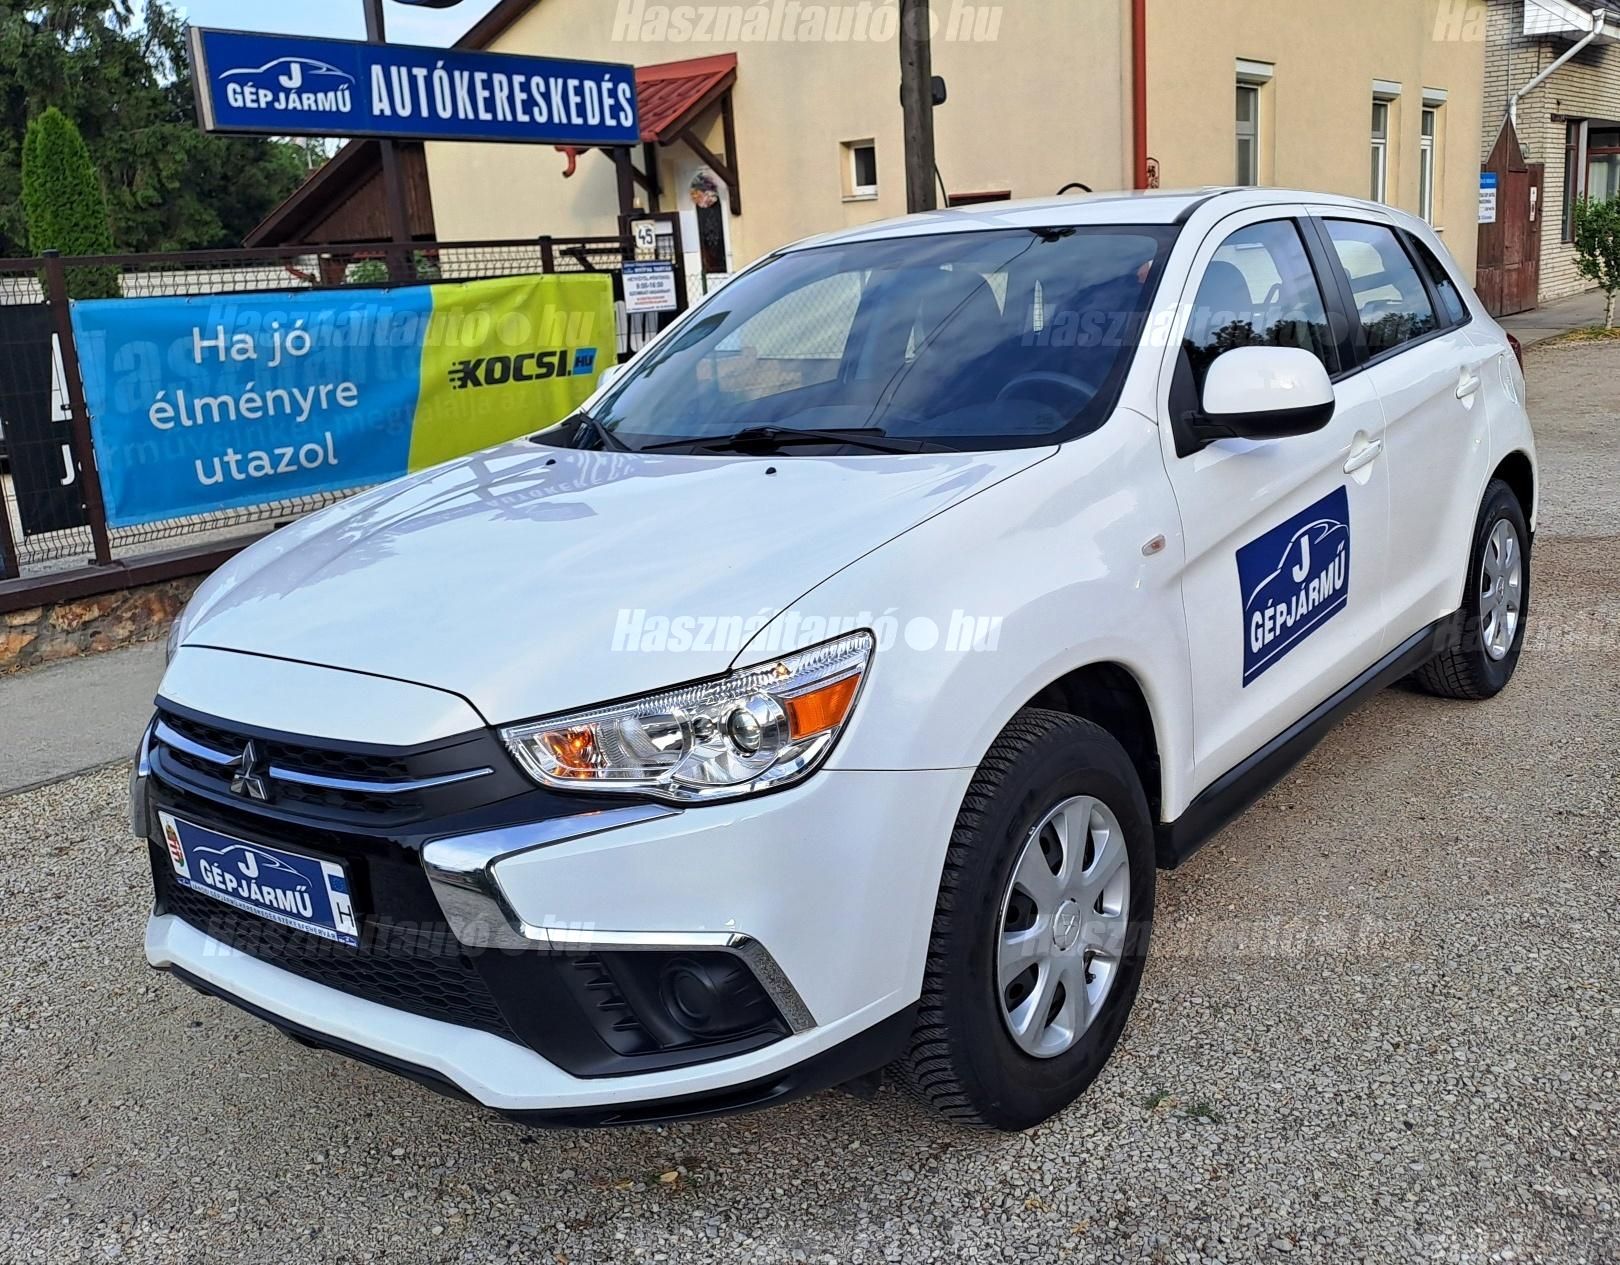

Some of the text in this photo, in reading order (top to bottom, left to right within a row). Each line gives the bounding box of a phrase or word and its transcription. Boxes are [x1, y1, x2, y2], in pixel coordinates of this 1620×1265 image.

[226, 82, 352, 113] GÉPJÁRMŰ
[278, 62, 303, 89] J
[370, 60, 634, 128] AUTÓKERESKEDÉS
[637, 228, 654, 245] 45
[192, 319, 312, 367] Ha jó
[149, 381, 359, 430] élményre
[195, 431, 339, 486] utazol
[1292, 534, 1311, 583] J
[1250, 539, 1346, 653] GÉPJÁRMŰ
[200, 859, 313, 918] GÉPJÁRMŰ
[237, 851, 260, 878] J
